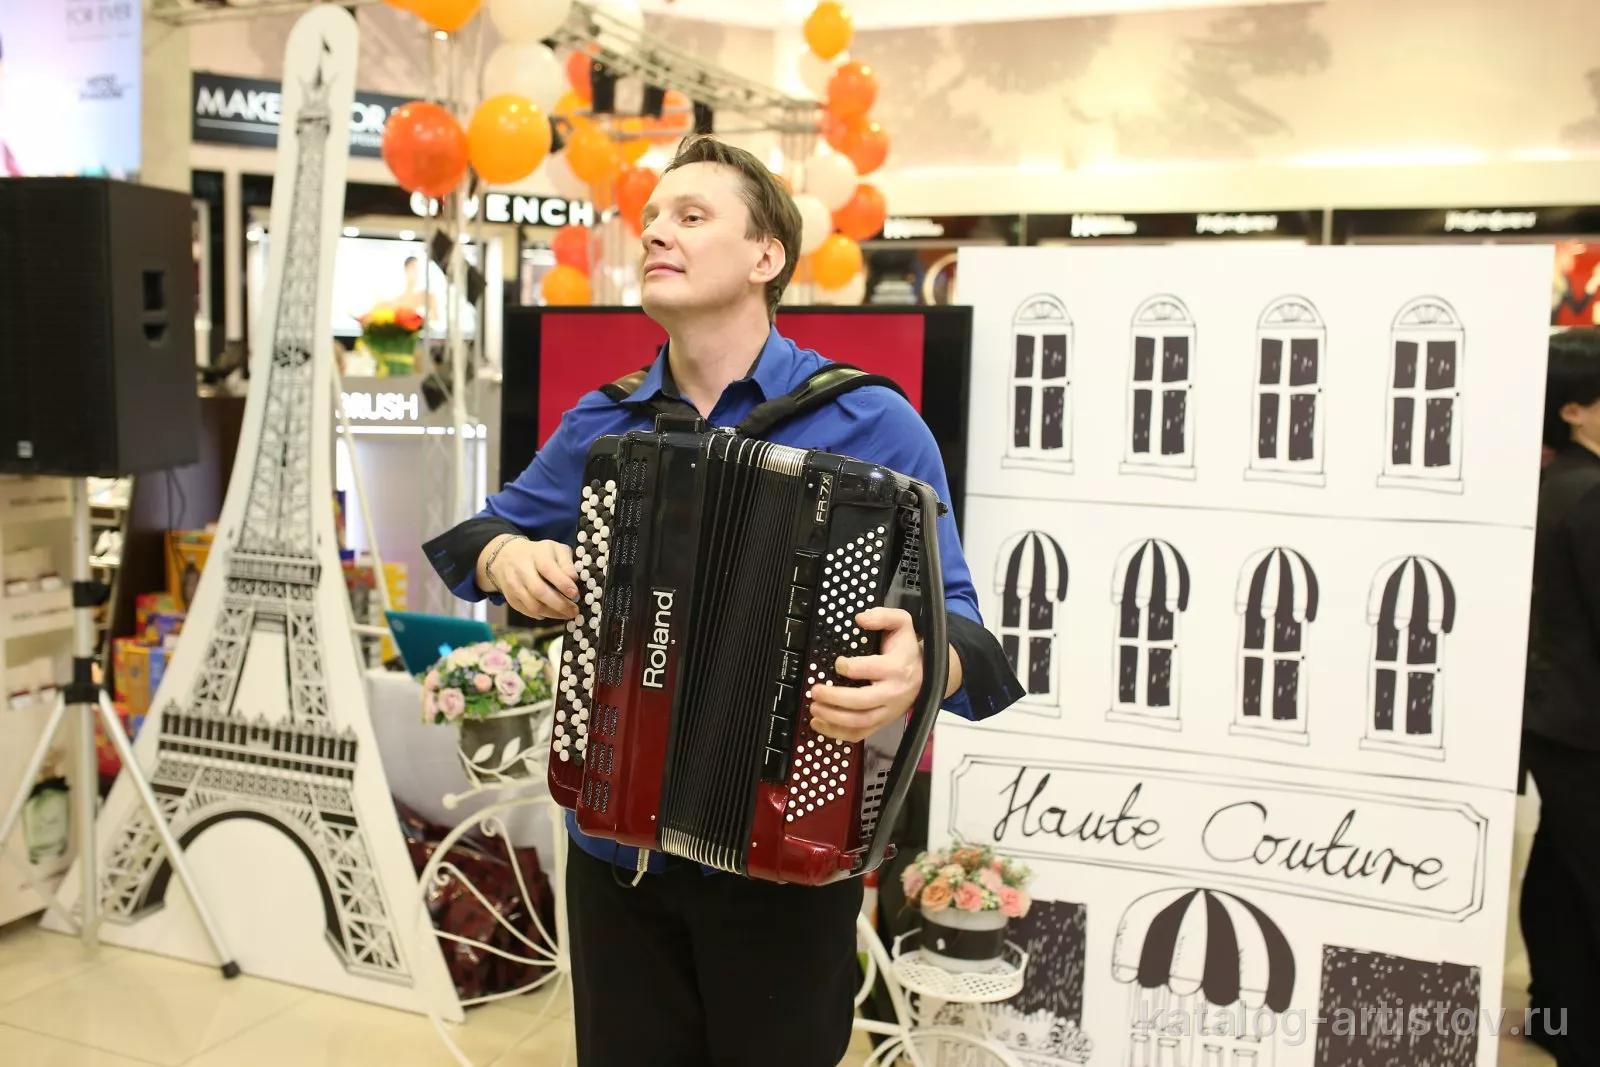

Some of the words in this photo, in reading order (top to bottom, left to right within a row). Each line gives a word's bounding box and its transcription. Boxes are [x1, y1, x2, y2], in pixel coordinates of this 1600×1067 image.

[196, 86, 282, 123] MAKE
[409, 190, 615, 228] GVENCH
[642, 590, 674, 689] Roland
[993, 766, 1165, 850] Haute
[1202, 801, 1448, 890] Couture
